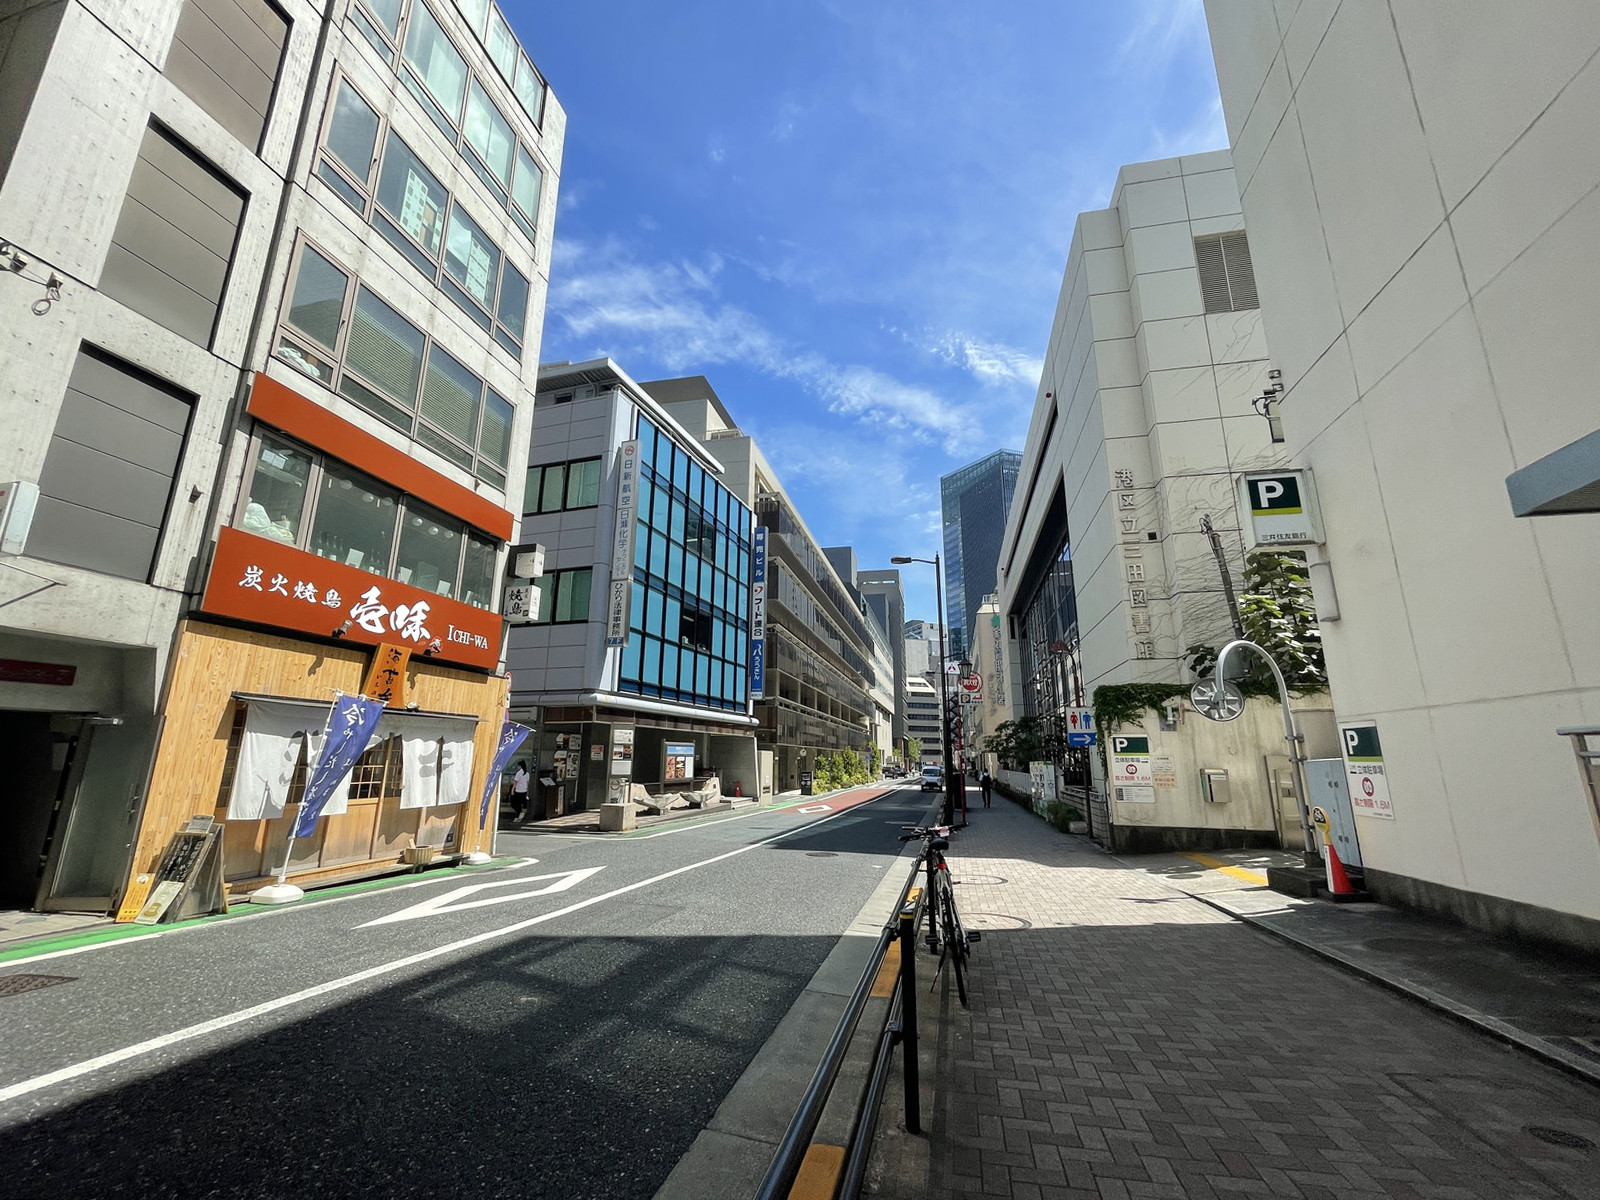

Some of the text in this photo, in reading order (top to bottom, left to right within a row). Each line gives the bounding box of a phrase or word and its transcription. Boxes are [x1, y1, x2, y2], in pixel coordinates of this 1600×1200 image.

[621, 459, 632, 506] 日新航空
[1257, 481, 1284, 507] P
[1261, 532, 1307, 541] 三井住友銀行
[1115, 469, 1155, 659] 港区立三田図書館
[238, 564, 431, 643] 炭火焼鳥 壱味
[508, 588, 523, 615] 焼鳥
[611, 582, 623, 637] ひかり法律事務所
[753, 598, 763, 637] フード連合
[447, 624, 488, 650] ICHI-WA
[1116, 738, 1128, 752] P
[1346, 730, 1358, 755] P
